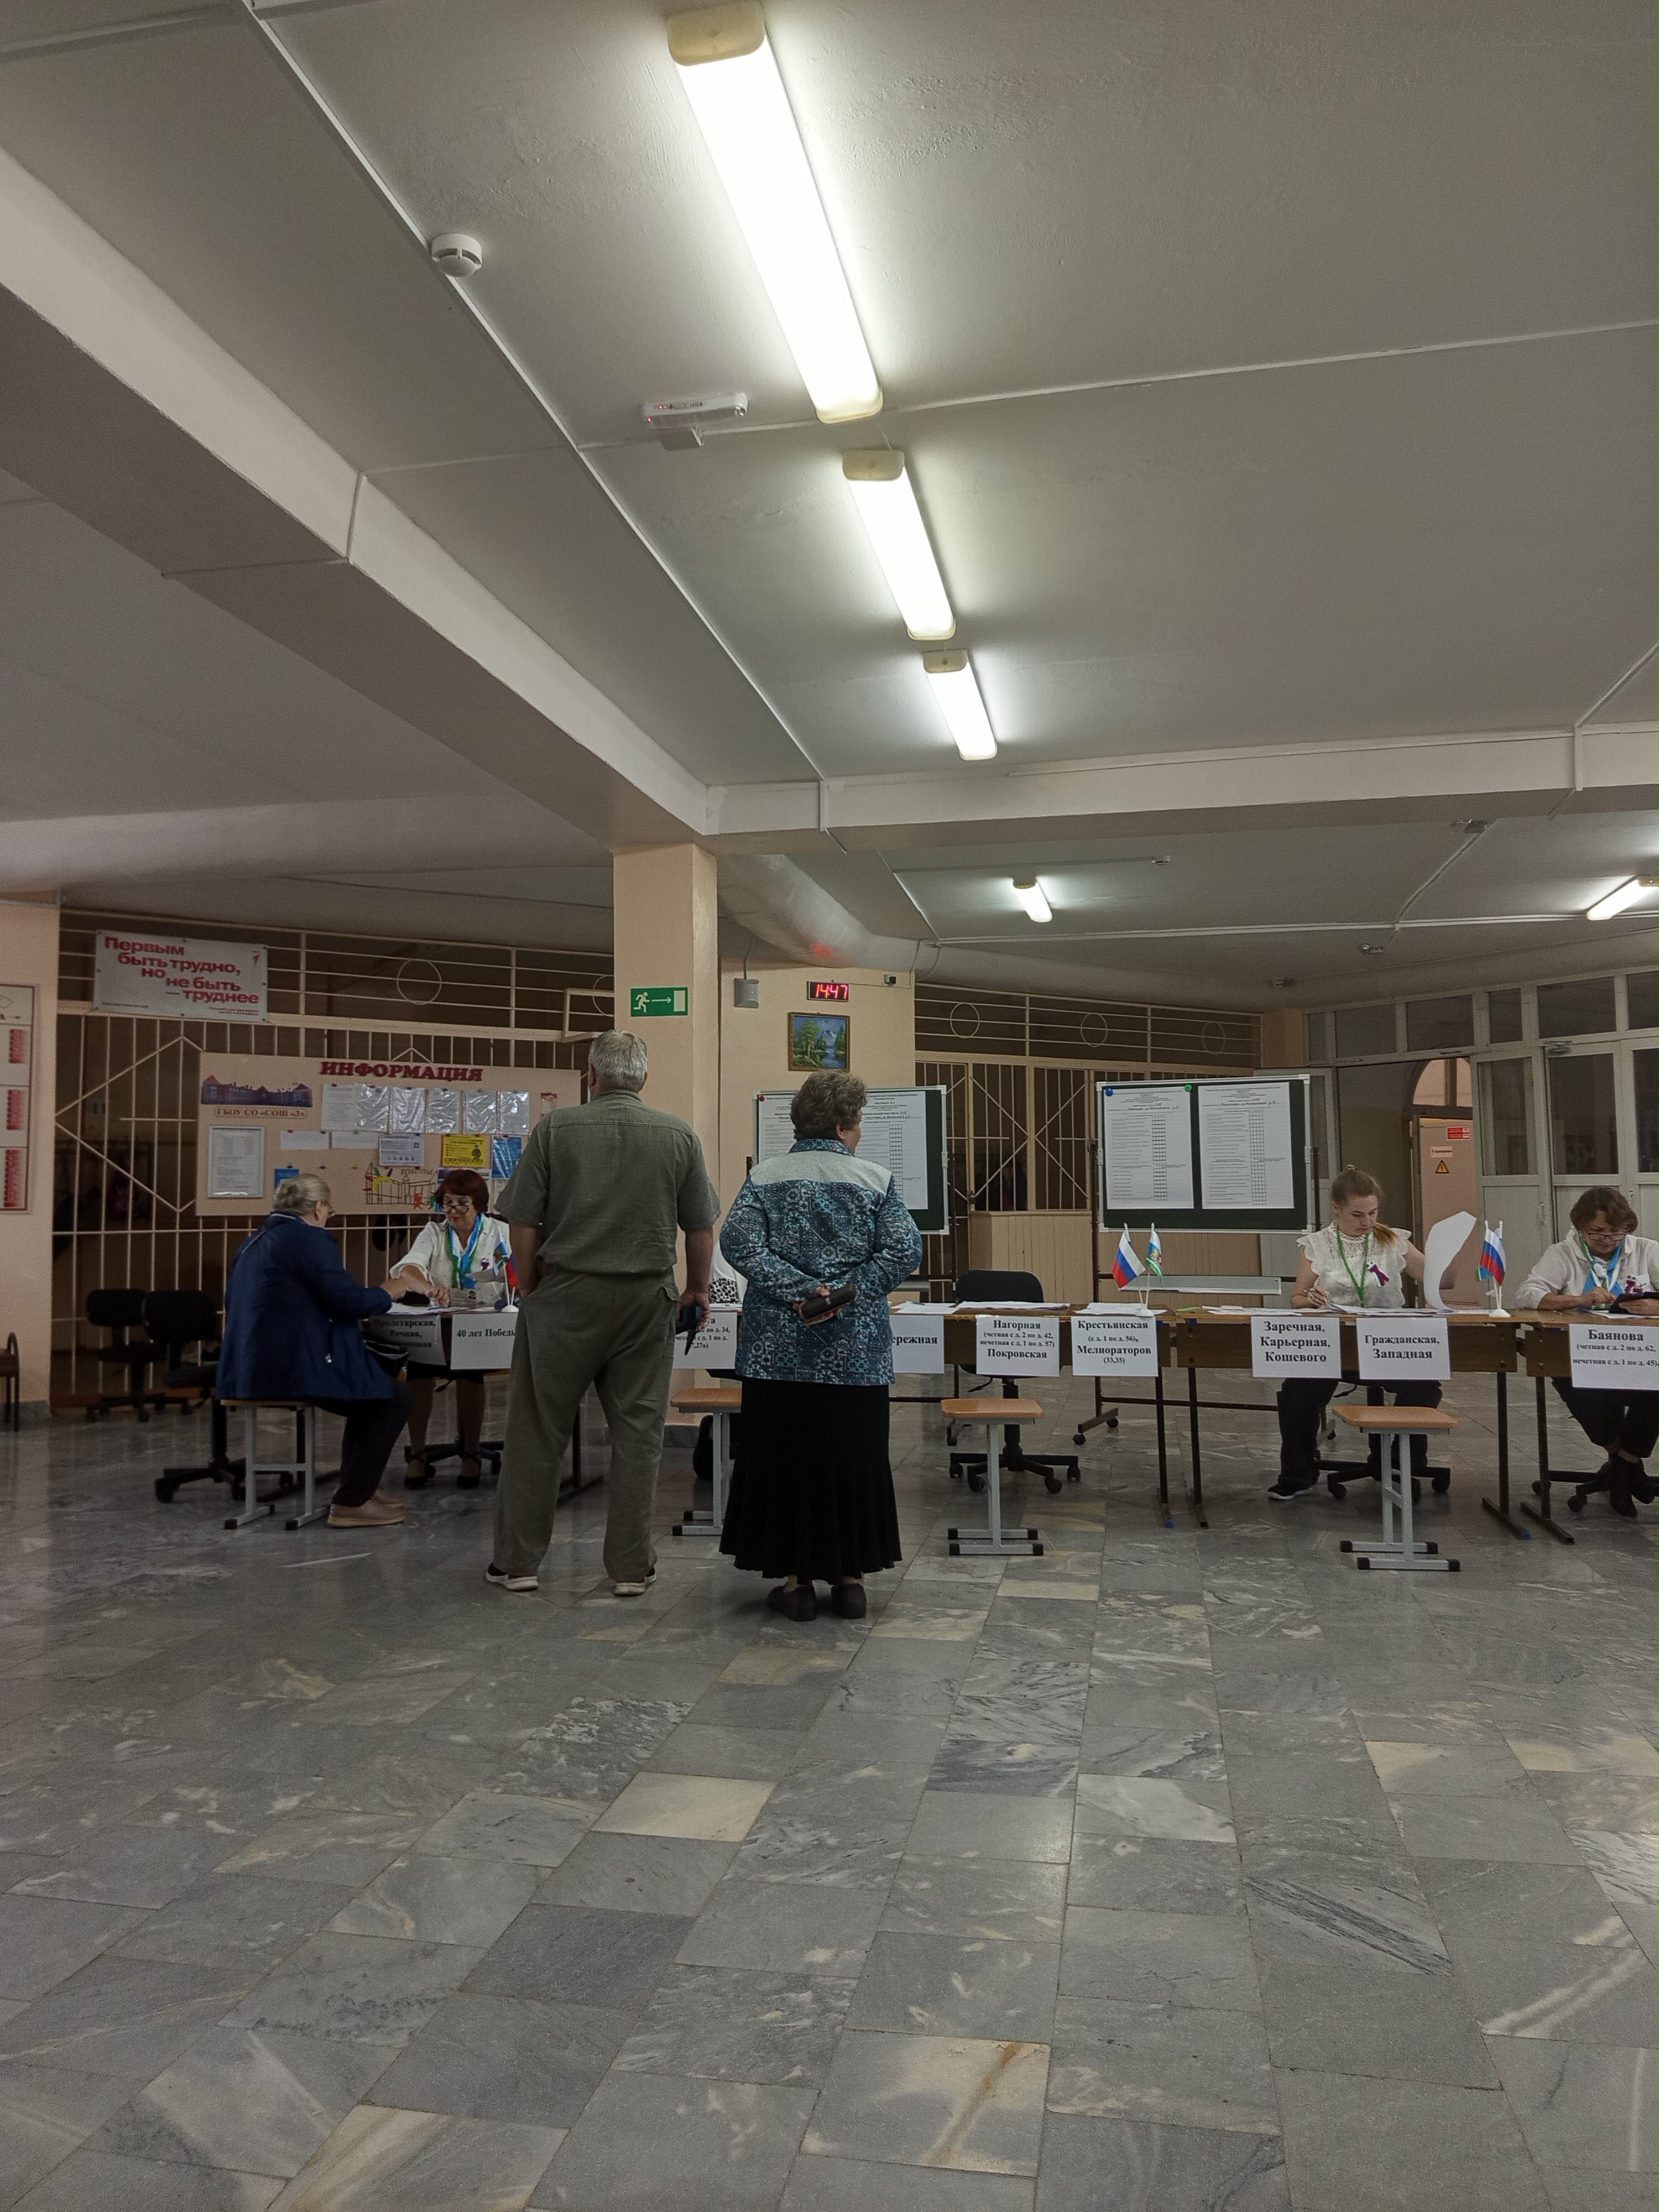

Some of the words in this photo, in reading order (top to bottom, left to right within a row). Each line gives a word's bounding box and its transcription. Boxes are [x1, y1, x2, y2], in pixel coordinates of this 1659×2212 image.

[105, 936, 185, 955] Первым
[118, 952, 168, 967] быть
[170, 959, 241, 975] трудно,
[142, 968, 166, 978] но
[166, 977, 190, 988] не
[193, 977, 242, 991] быть
[182, 989, 259, 1004] труднее
[816, 984, 848, 999] 14:47
[320, 1061, 483, 1082] ИНФОРМАЦИЯ
[993, 1319, 1041, 1331] Нагорная
[1078, 1320, 1148, 1331] Крестьянская
[1264, 1321, 1326, 1334] Заречная,
[892, 1335, 938, 1345] ережная
[1364, 1334, 1441, 1345] Гражданская,
[1588, 1329, 1644, 1341] Баянова
[1260, 1336, 1331, 1349] Карьерная,
[988, 1348, 1047, 1359] Покровская
[1077, 1345, 1151, 1357] Мелиораторов
[1265, 1352, 1327, 1362] Кошевого
[1373, 1348, 1433, 1360] Западная
